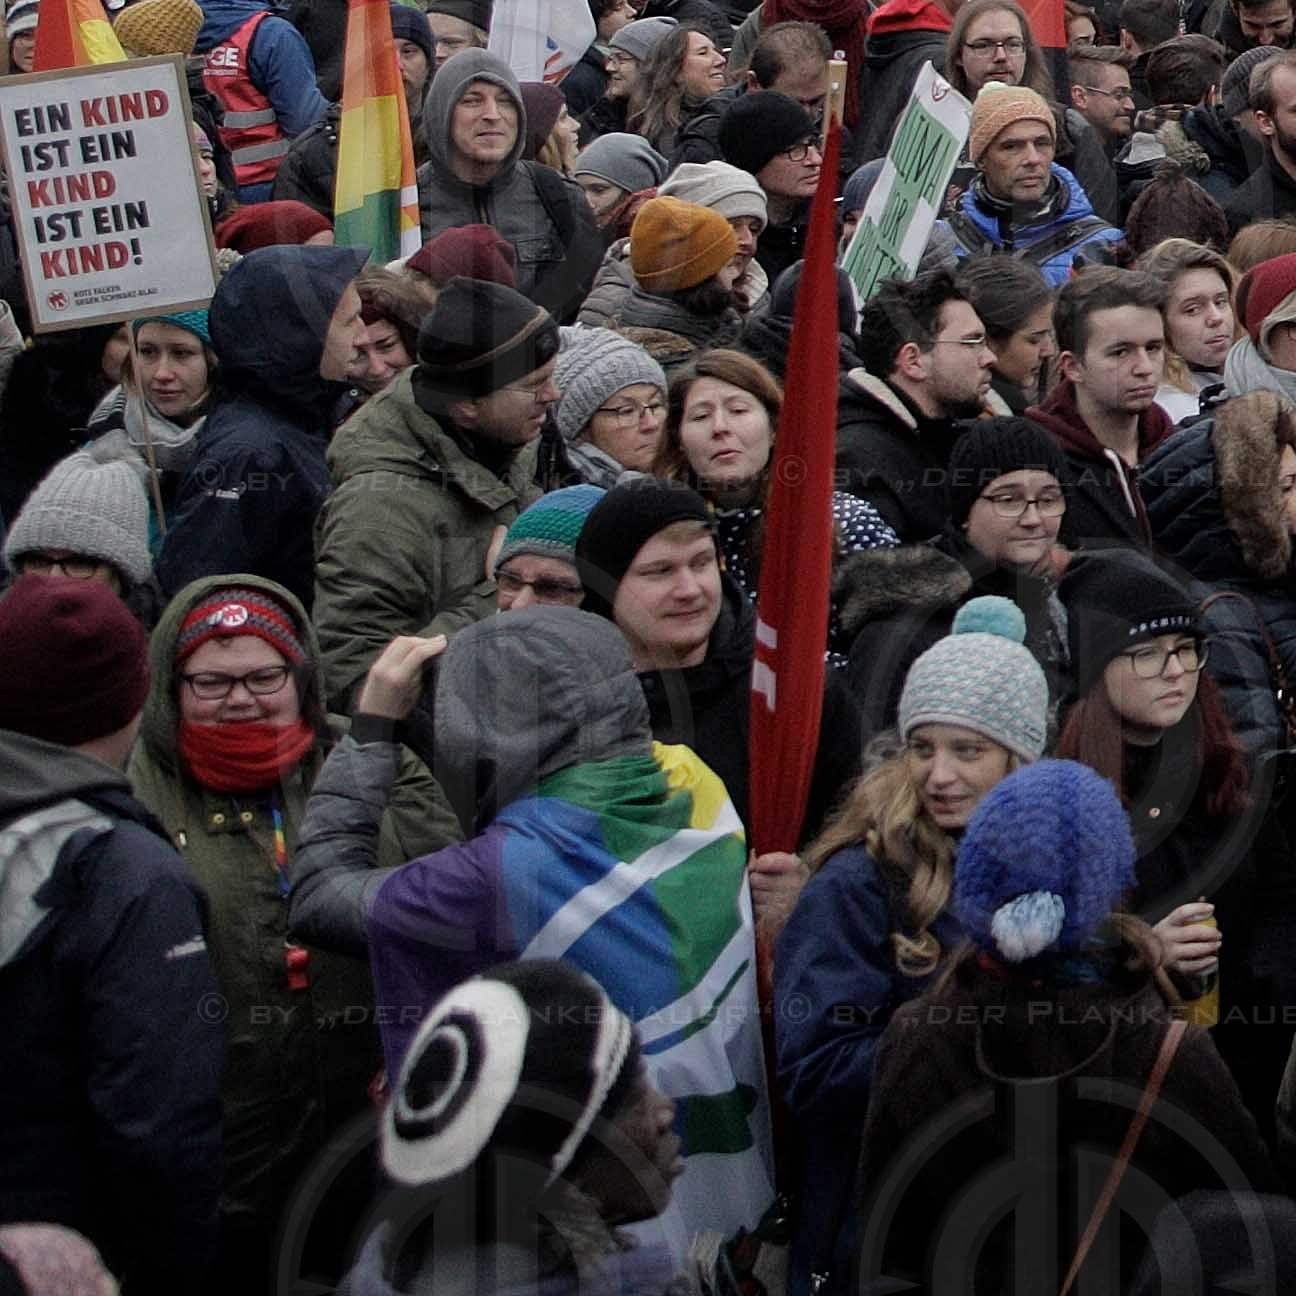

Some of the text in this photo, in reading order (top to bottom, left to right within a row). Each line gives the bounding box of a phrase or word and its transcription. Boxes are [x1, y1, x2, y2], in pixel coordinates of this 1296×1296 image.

[14, 89, 170, 138] EIN KIND
[21, 129, 137, 173] IST EIN
[28, 170, 116, 208] KIND
[34, 200, 151, 244] IST EIN
[40, 237, 144, 280] KIND!
